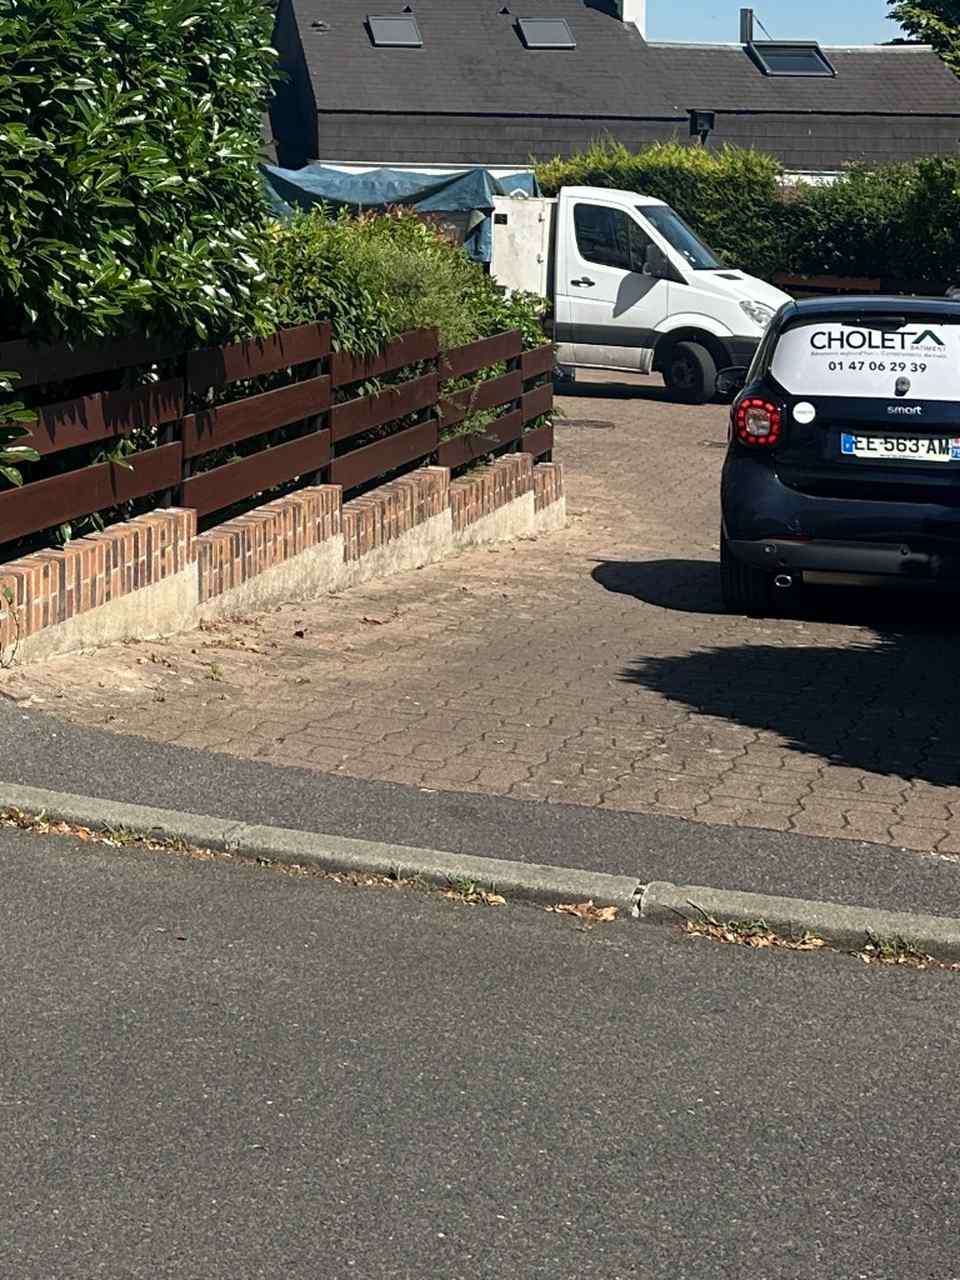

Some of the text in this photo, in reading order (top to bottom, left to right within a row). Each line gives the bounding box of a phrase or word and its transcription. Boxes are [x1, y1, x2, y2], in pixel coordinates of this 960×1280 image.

[810, 330, 917, 350] CHOLET
[828, 361, 927, 373] 01 47 06 29 39
[887, 405, 922, 415] smart
